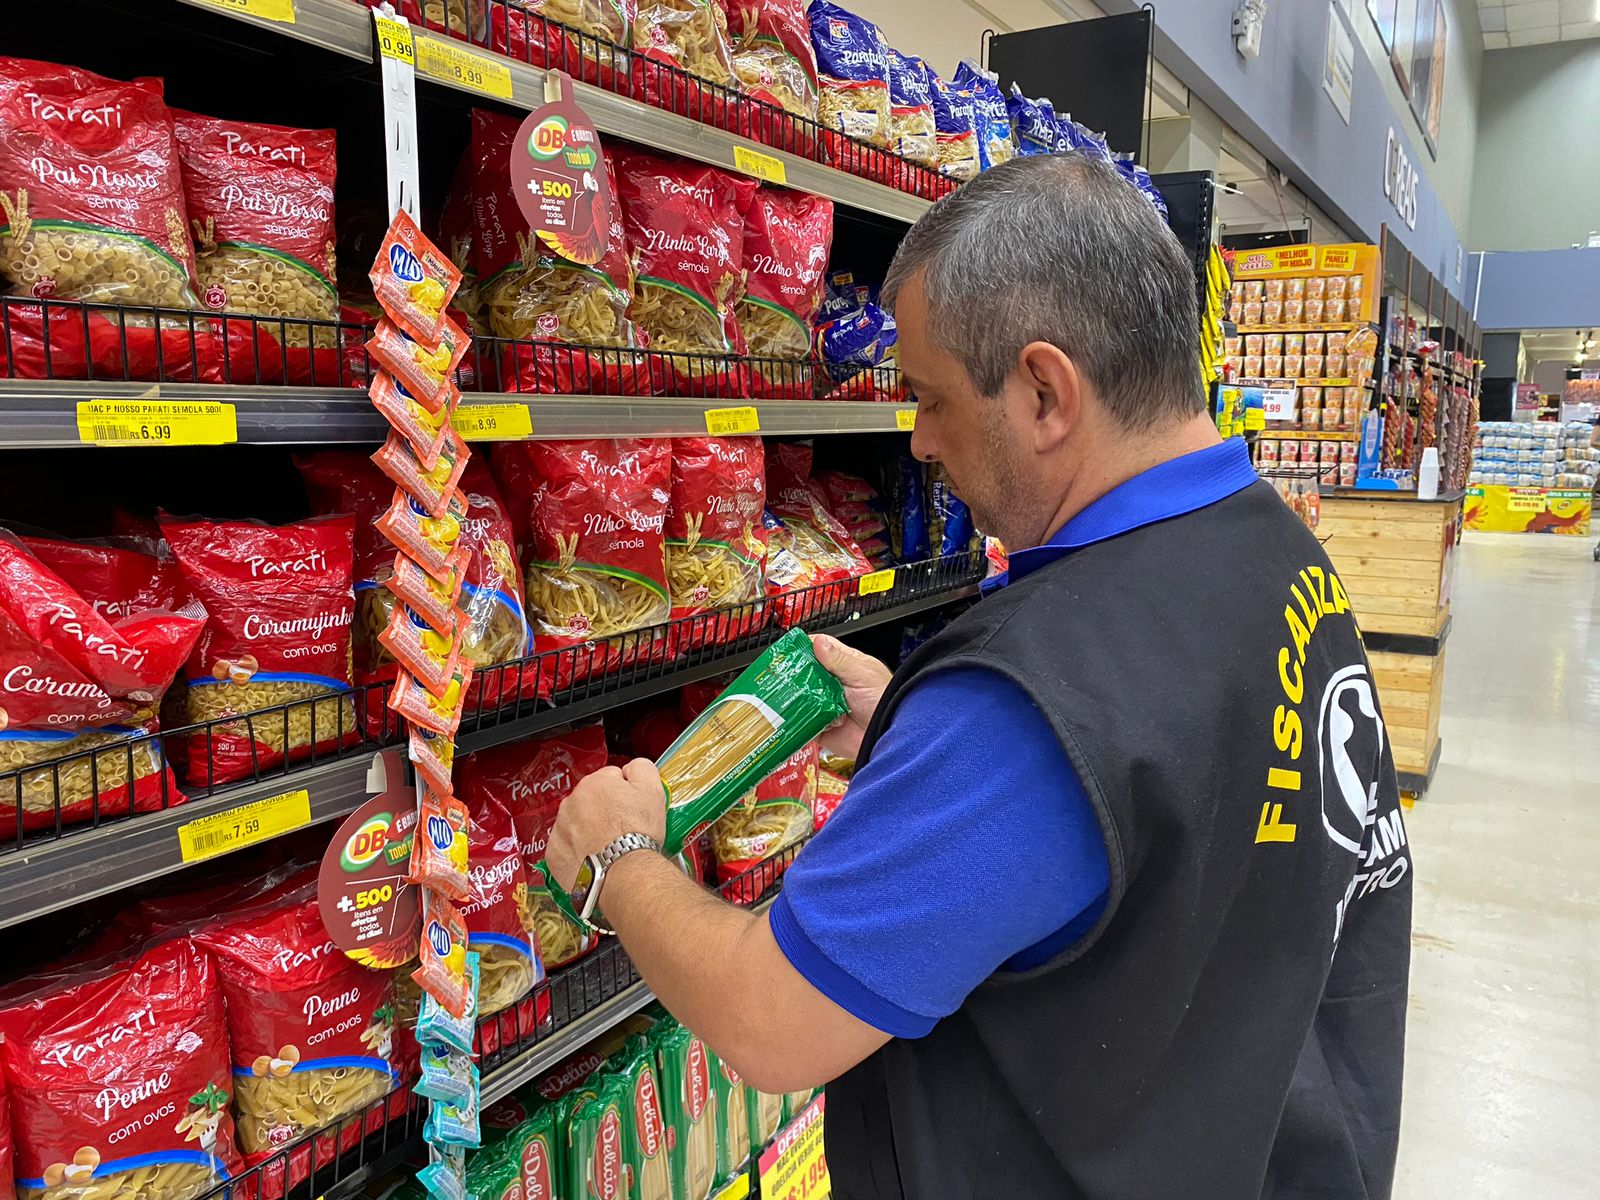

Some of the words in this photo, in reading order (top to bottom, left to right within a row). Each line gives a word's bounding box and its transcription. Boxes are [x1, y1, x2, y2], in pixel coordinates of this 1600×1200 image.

[383, 37, 413, 57] 0,99
[454, 66, 482, 85] 8,99
[24, 92, 122, 130] Parati
[219, 131, 306, 167] Parati
[537, 127, 563, 148] DB
[31, 156, 81, 186] Pai
[80, 163, 161, 191] Nosso
[654, 176, 714, 208] Parati
[645, 228, 695, 252] Ninho
[677, 259, 710, 275] sêmola
[753, 253, 793, 277] Ninho
[106, 404, 111, 413] P
[114, 405, 140, 414] NOSSO
[143, 405, 170, 414] PARATI
[172, 405, 203, 414] SEMOLA
[141, 425, 171, 442] 6,99
[478, 418, 497, 431] 8,99
[626, 509, 666, 535] Larg
[245, 549, 327, 578] Parati
[92, 598, 132, 617] rati
[243, 606, 354, 640] Caramujinho
[49, 602, 150, 671] Parati
[283, 647, 310, 659] com
[311, 642, 337, 655] ovos
[47, 712, 86, 725] com
[88, 708, 125, 723] ovos
[1254, 565, 1351, 844] FISCALIZA
[217, 742, 231, 751] 500
[506, 768, 572, 801] Parati
[233, 819, 260, 840] 7,59
[353, 829, 386, 857] DB
[388, 846, 408, 861] TODO
[517, 839, 546, 858] inho
[371, 905, 383, 915] em
[482, 891, 505, 910] ovos
[351, 915, 378, 928] ofertas
[359, 921, 380, 933] todos
[356, 933, 367, 942] os
[272, 940, 340, 974] Para
[303, 987, 360, 1026] Penne
[41, 1002, 156, 1069] Parati
[307, 1027, 335, 1046] com
[337, 1015, 362, 1034] ovos
[94, 1071, 172, 1122] Penne
[108, 1121, 142, 1145] com
[143, 1102, 176, 1125] ovos
[777, 1103, 820, 1156] OFERTA
[267, 1158, 280, 1171] 500
[524, 1155, 543, 1200] Deli
